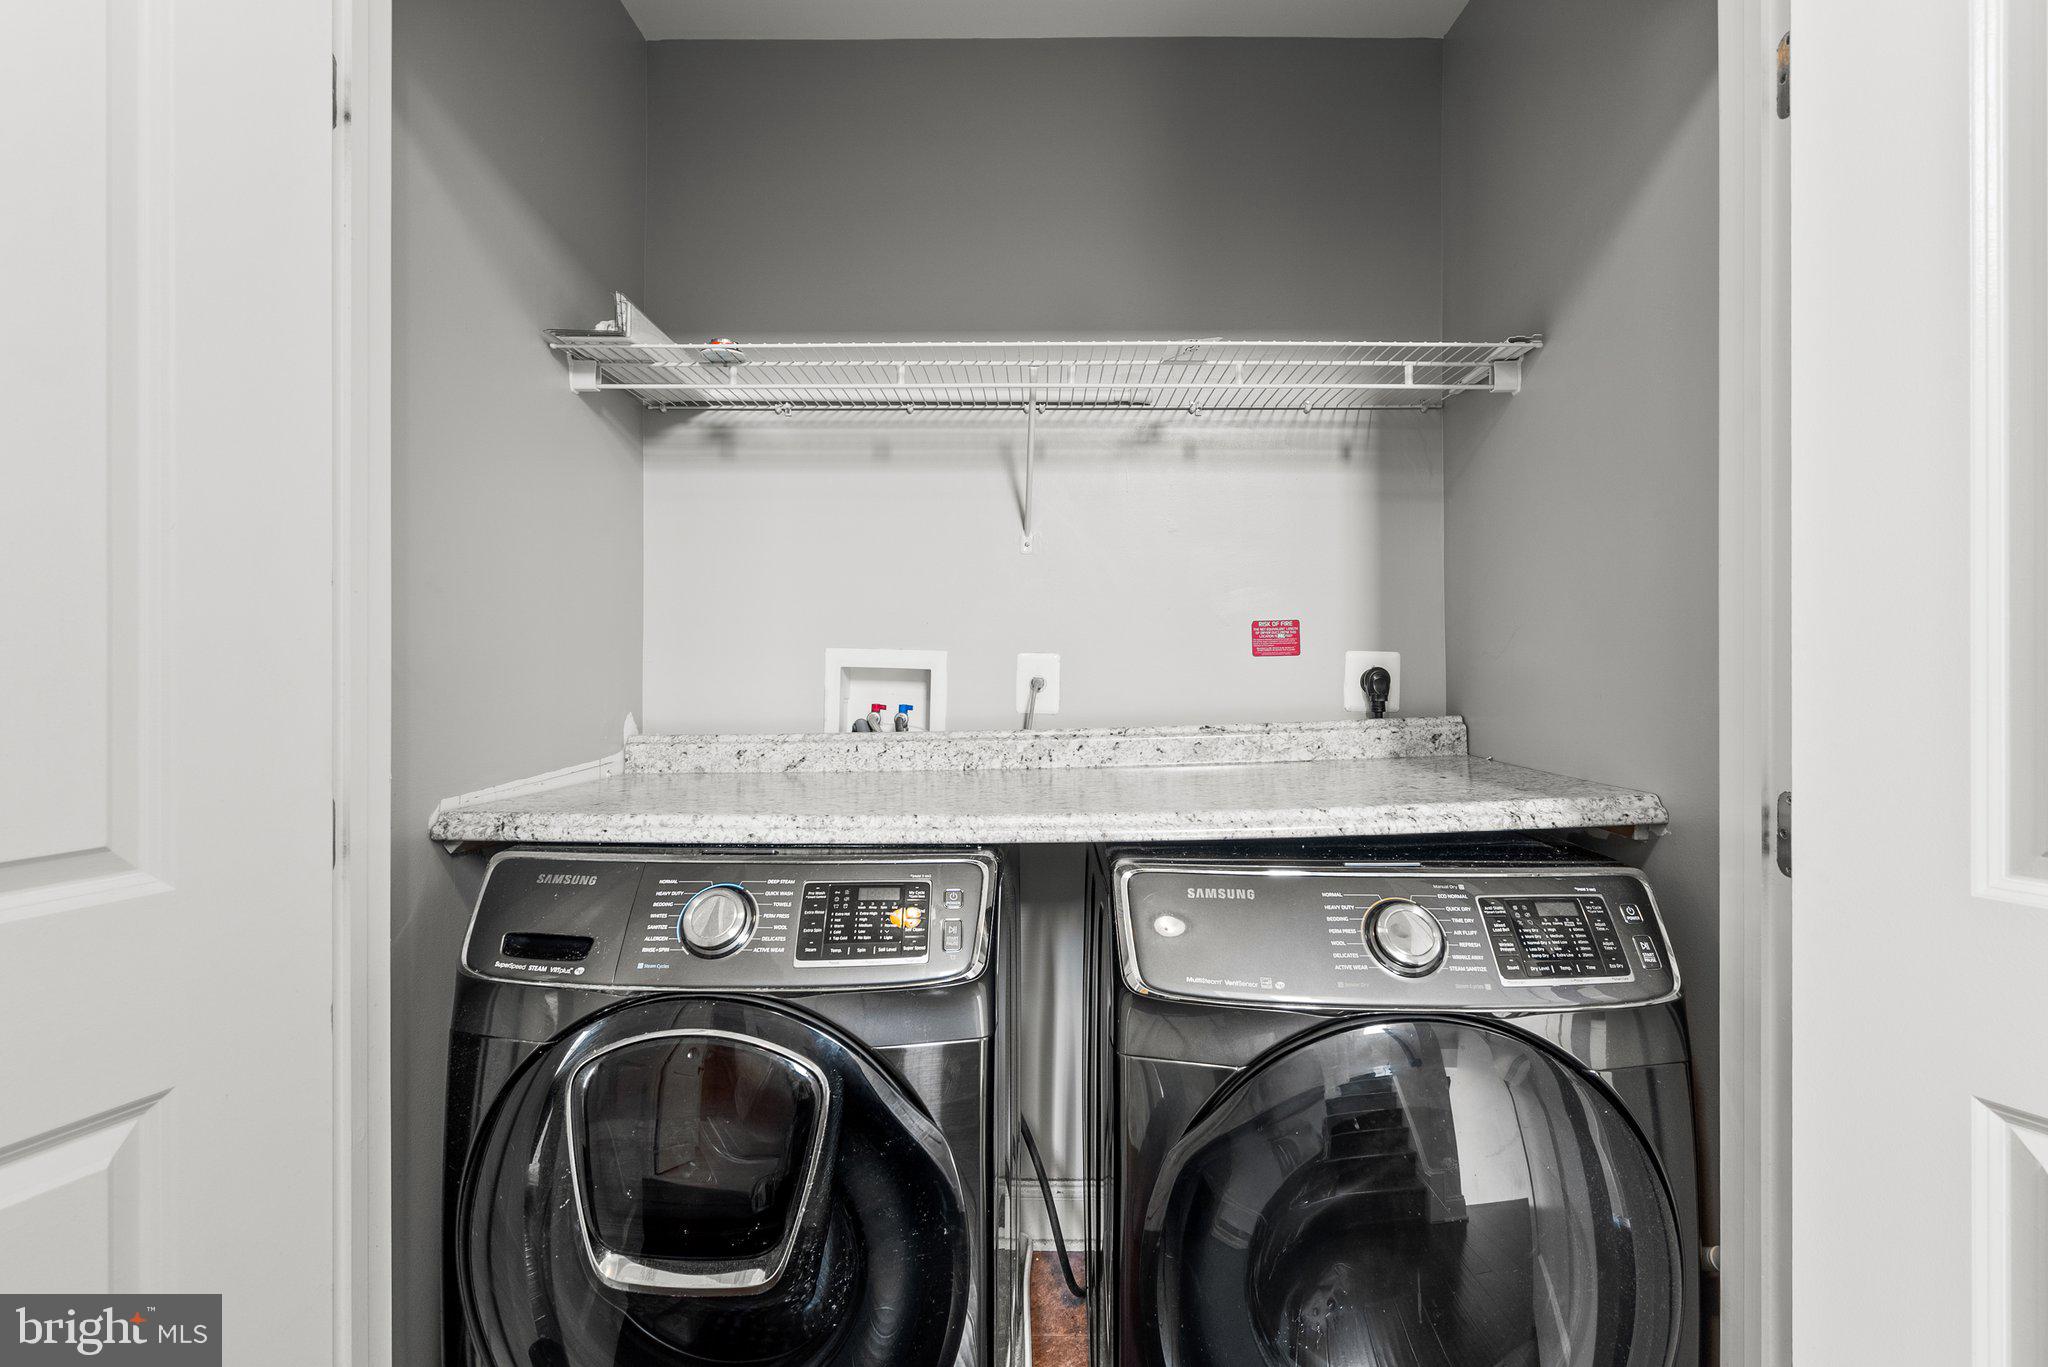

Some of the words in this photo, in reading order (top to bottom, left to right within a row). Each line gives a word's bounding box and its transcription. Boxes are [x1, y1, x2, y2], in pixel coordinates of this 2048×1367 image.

[537, 873, 598, 886] SAMSUNG
[1187, 888, 1255, 900] SAMSUNG
[494, 961, 526, 970] SuperSpeed
